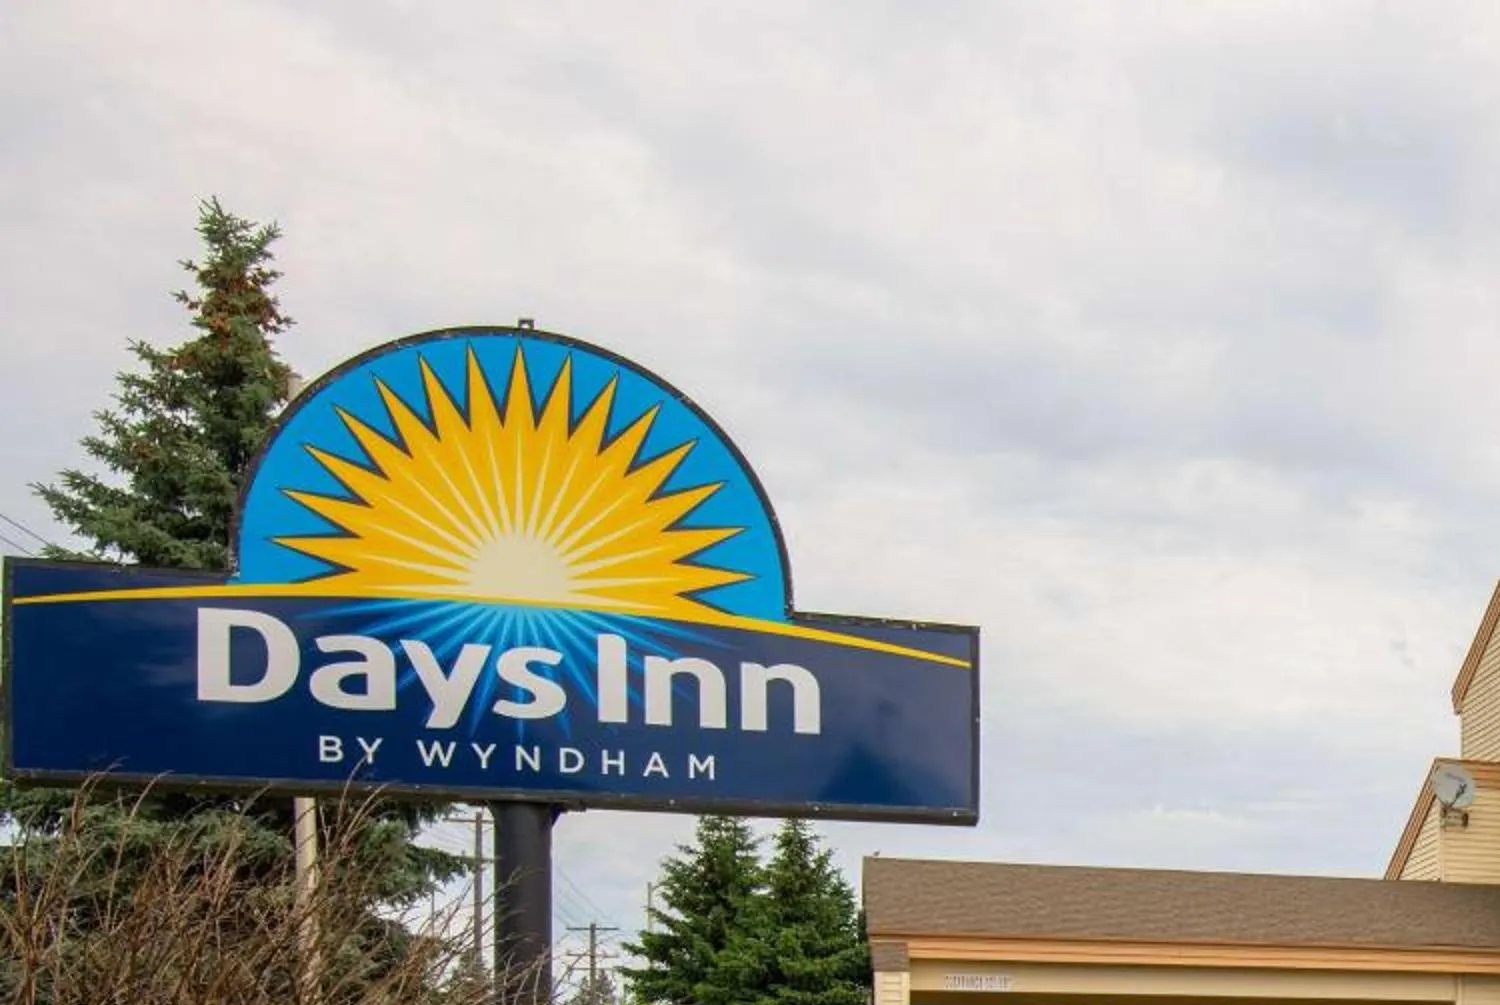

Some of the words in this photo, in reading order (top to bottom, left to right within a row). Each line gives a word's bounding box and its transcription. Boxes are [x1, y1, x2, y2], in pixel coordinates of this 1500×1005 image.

[197, 607, 567, 728] Days
[597, 633, 821, 734] Inn
[318, 735, 383, 763] BY
[416, 740, 715, 780] WYNDHAM
